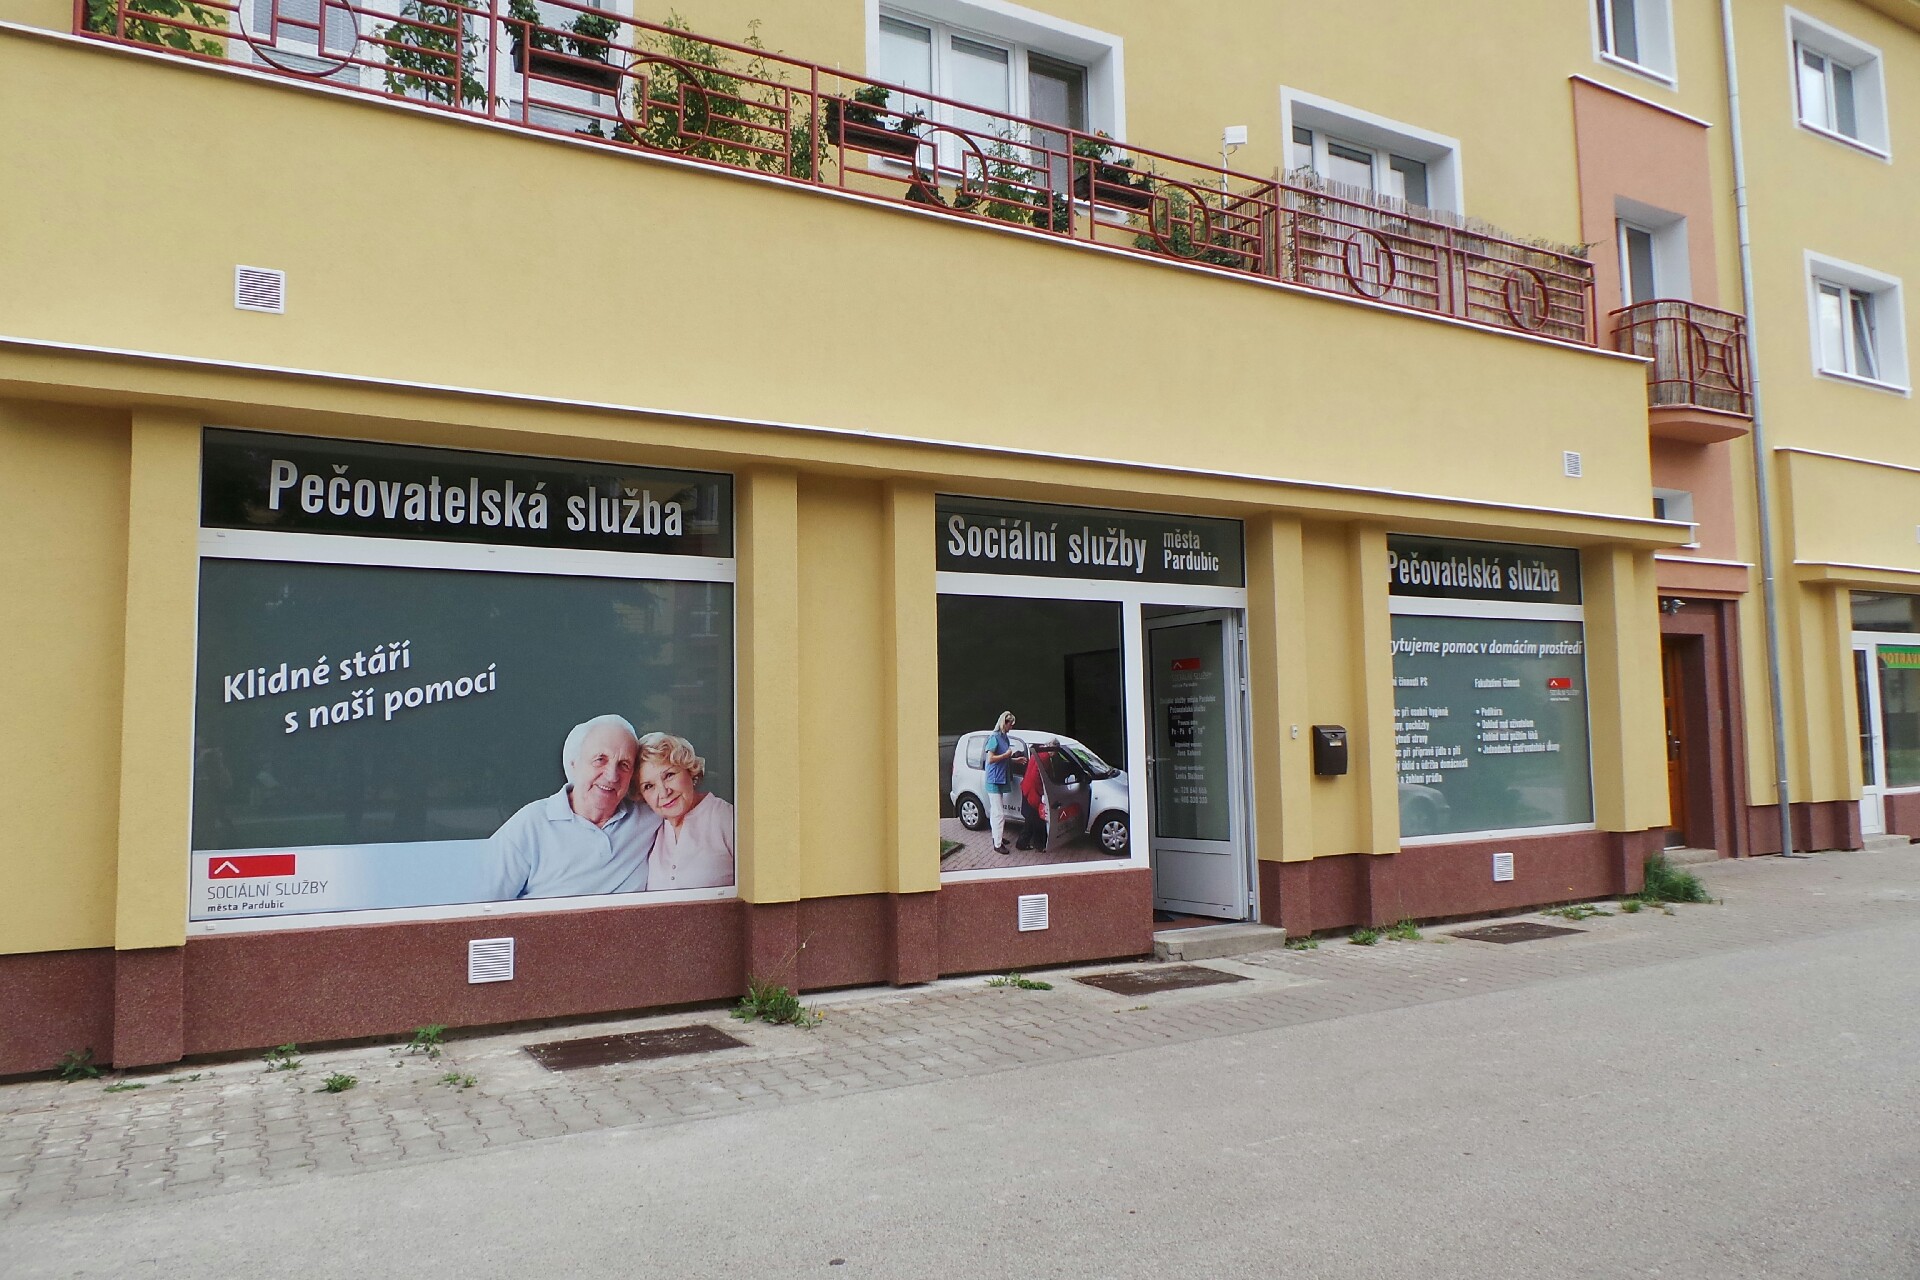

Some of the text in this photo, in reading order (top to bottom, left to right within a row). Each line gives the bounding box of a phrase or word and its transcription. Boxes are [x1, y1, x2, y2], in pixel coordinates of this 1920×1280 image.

[268, 459, 683, 537] Pečovatelská služba
[948, 514, 1147, 574] Sociální služby
[1163, 528, 1201, 550] města
[1164, 549, 1219, 572] Pardubic
[1387, 550, 1560, 593] Pečovatelská služba
[1391, 638, 1583, 659] ytujeme pomoc v domácím prostředí
[223, 639, 412, 703] Klidné stáří
[284, 662, 497, 734] s naší pomocí
[207, 880, 329, 900] SOCIÁLNÍ SLUŽBY
[207, 900, 285, 913] města Pardubic
